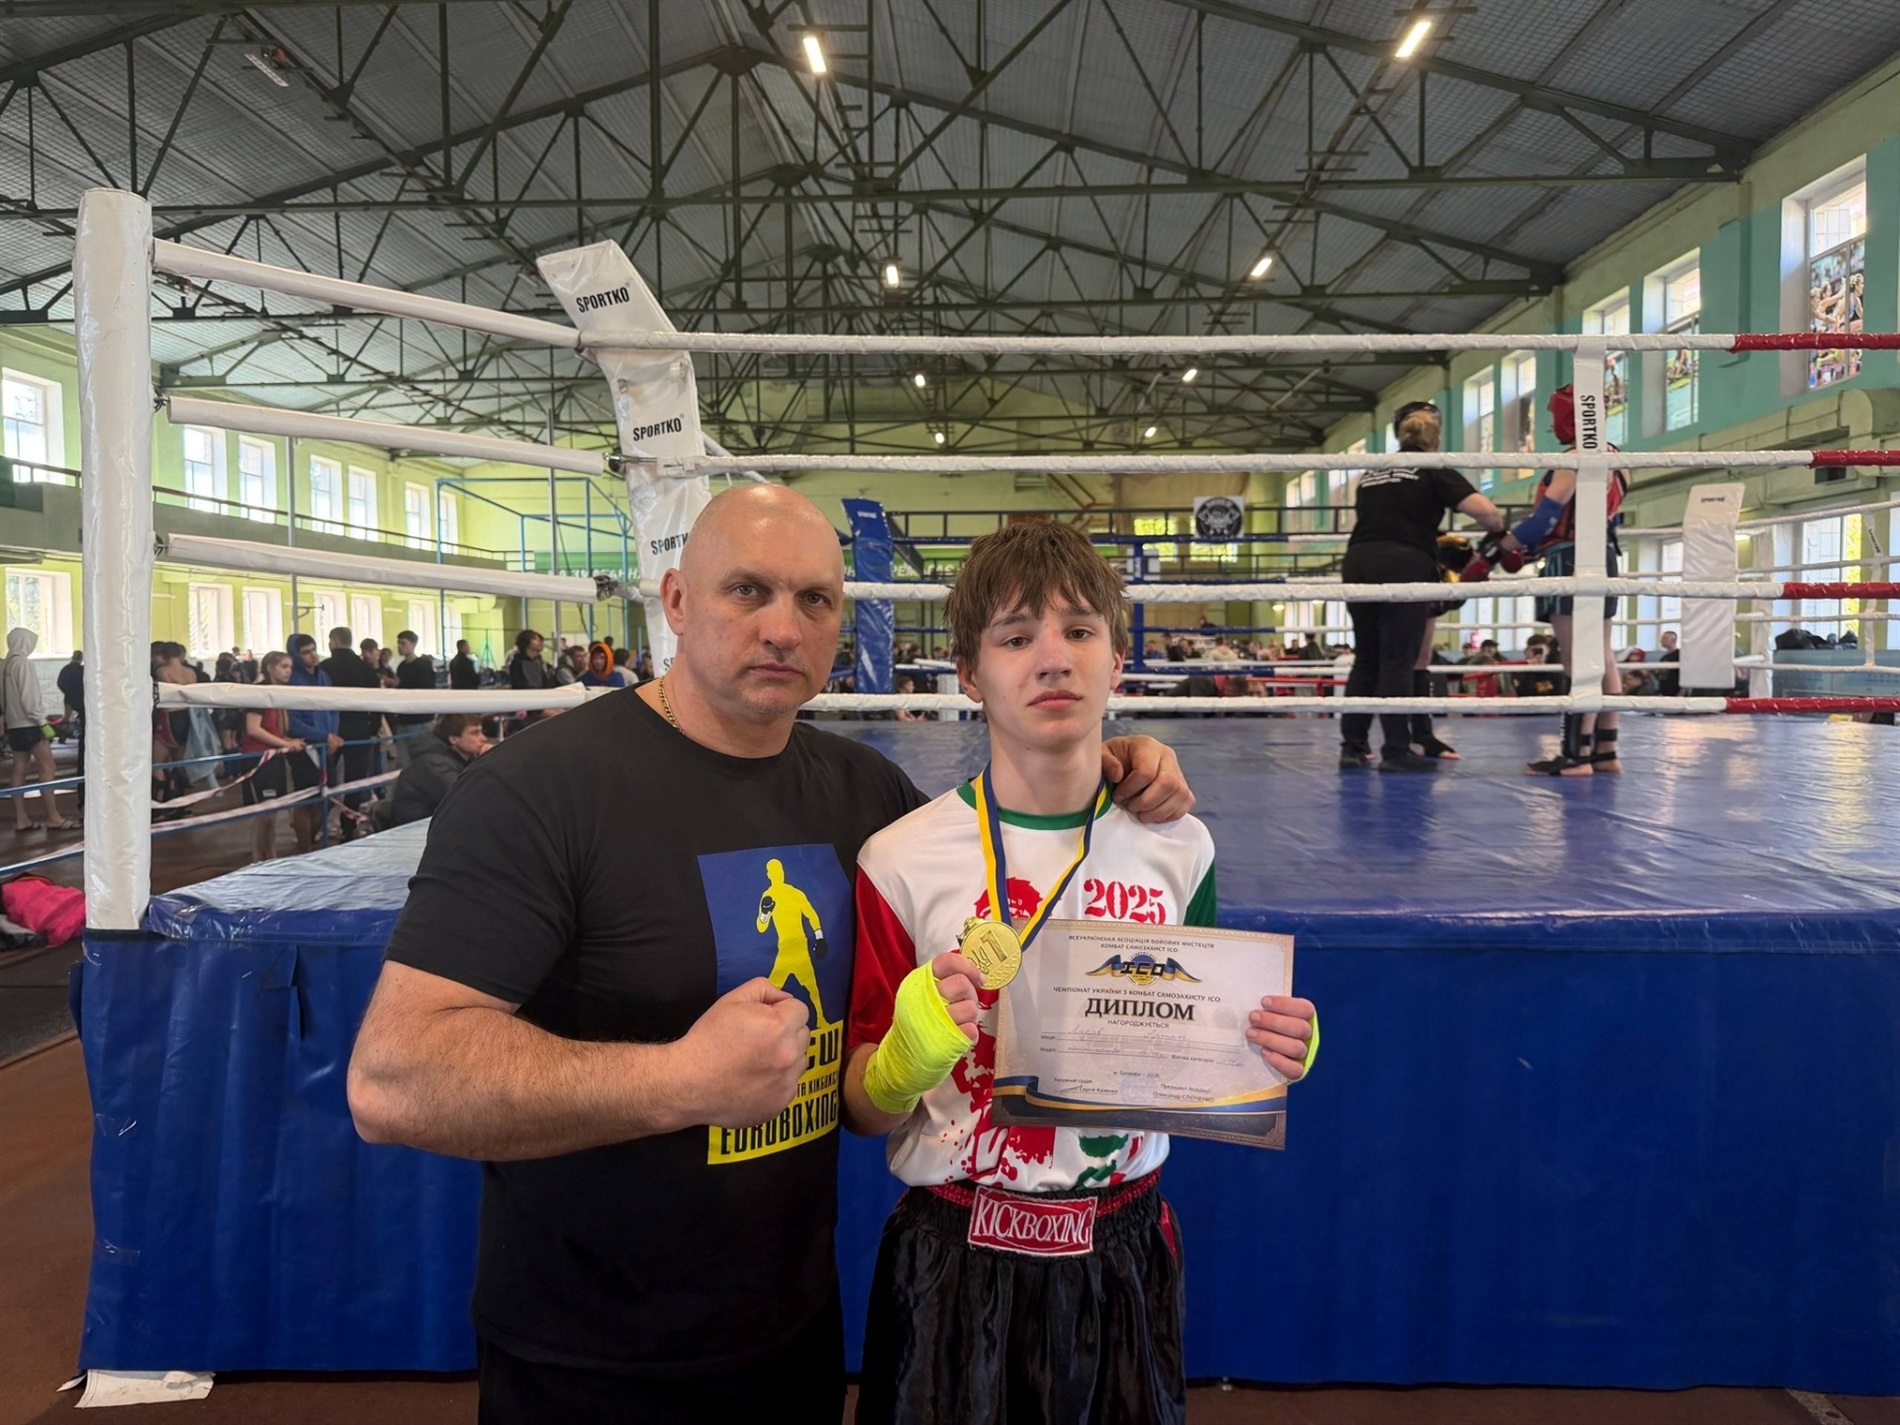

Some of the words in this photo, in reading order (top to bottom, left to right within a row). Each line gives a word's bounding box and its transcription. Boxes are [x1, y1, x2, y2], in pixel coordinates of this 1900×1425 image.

[576, 286, 630, 313] SPORTKO
[633, 417, 682, 441] SPORTKO
[1580, 395, 1598, 449] SPORTKO
[1083, 878, 1166, 925] 2025
[980, 930, 1008, 963] 1
[1126, 944, 1166, 952] САМОЗАХИСТ
[1182, 940, 1214, 949] МИСТЕЦТВ
[1092, 987, 1121, 995] УКРАЇНИ
[1129, 989, 1155, 997] КОМБАТ
[1156, 991, 1206, 1001] САМОЗАХИСТУ
[1084, 997, 1195, 1021] ДИПЛОМ
[1107, 1019, 1169, 1029] НАГОРОДЖУЄТЬСЯ
[972, 1193, 1093, 1245] KICKBOXING
